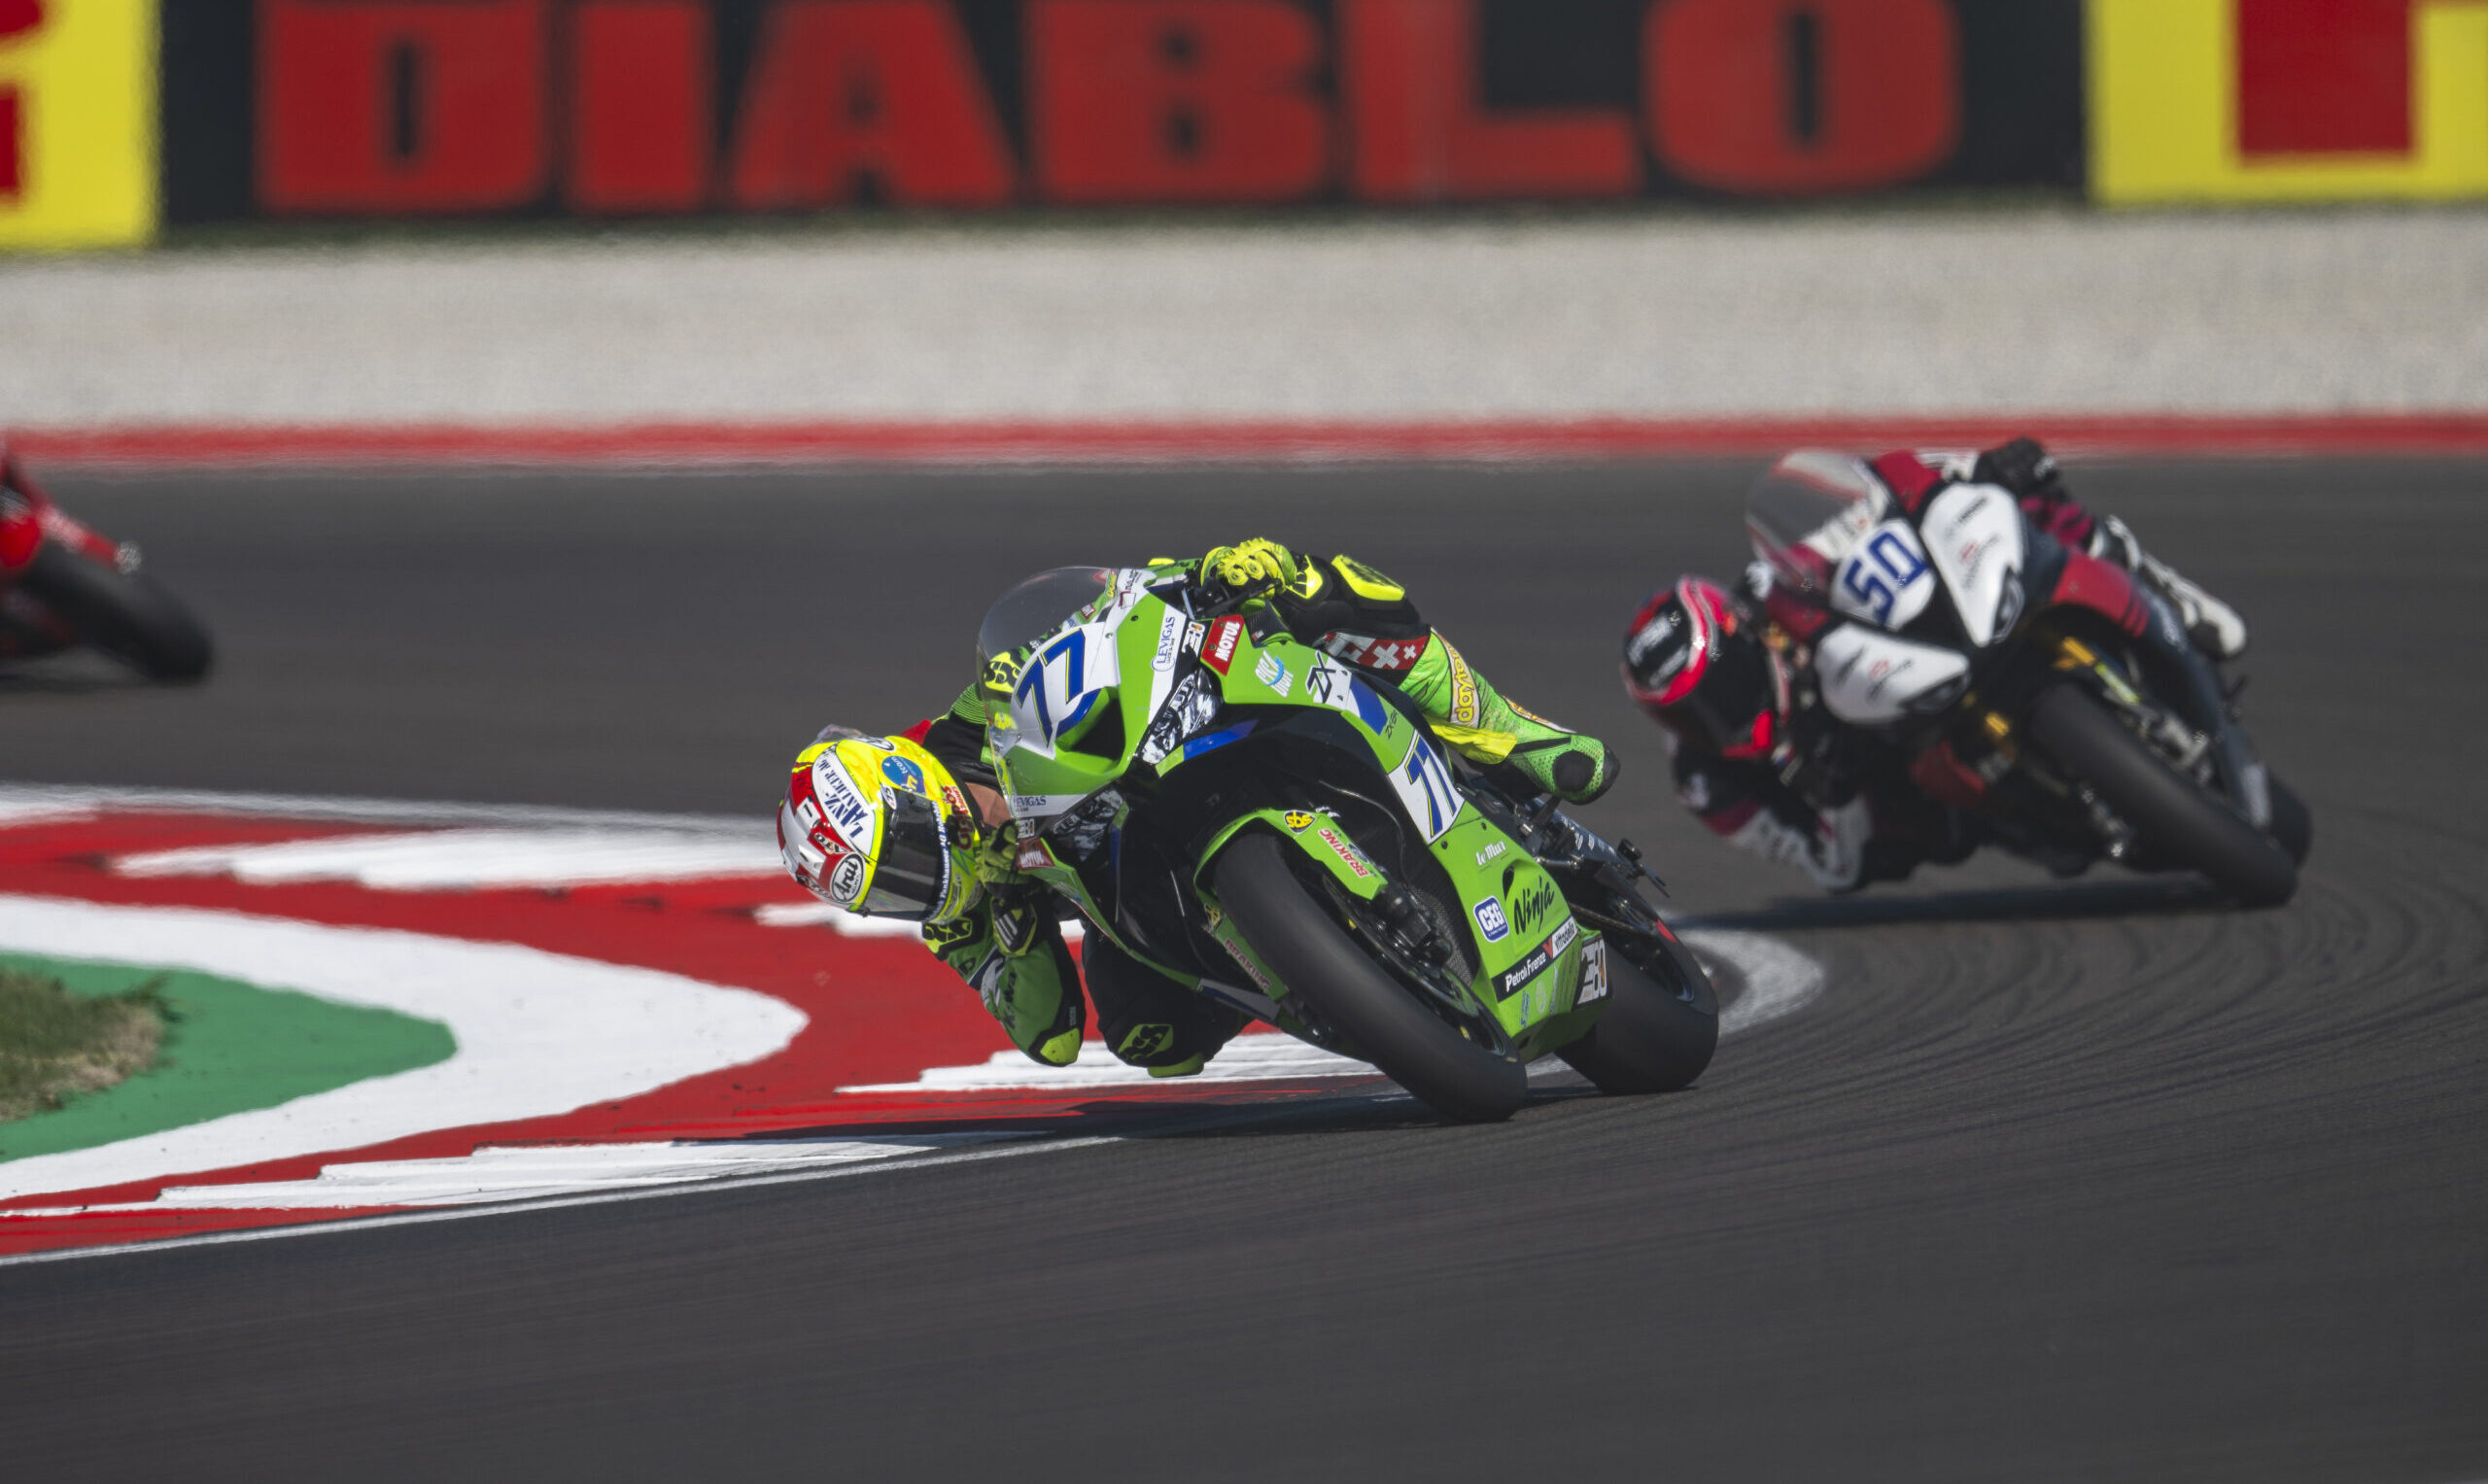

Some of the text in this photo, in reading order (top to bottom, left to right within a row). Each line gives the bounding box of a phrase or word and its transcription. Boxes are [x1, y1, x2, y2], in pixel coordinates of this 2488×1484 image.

[257, 0, 1965, 212] DIABLO
[1844, 531, 1930, 626] 50
[1157, 616, 1176, 666] LEVIGAS
[1215, 620, 1241, 662] MOTUL
[1015, 627, 1086, 747] 77
[1404, 734, 1460, 837] 77
[1286, 811, 1314, 829] sbs
[833, 860, 859, 895] Arai
[1318, 828, 1370, 878] BRAKING
[1513, 875, 1555, 935] Ninja
